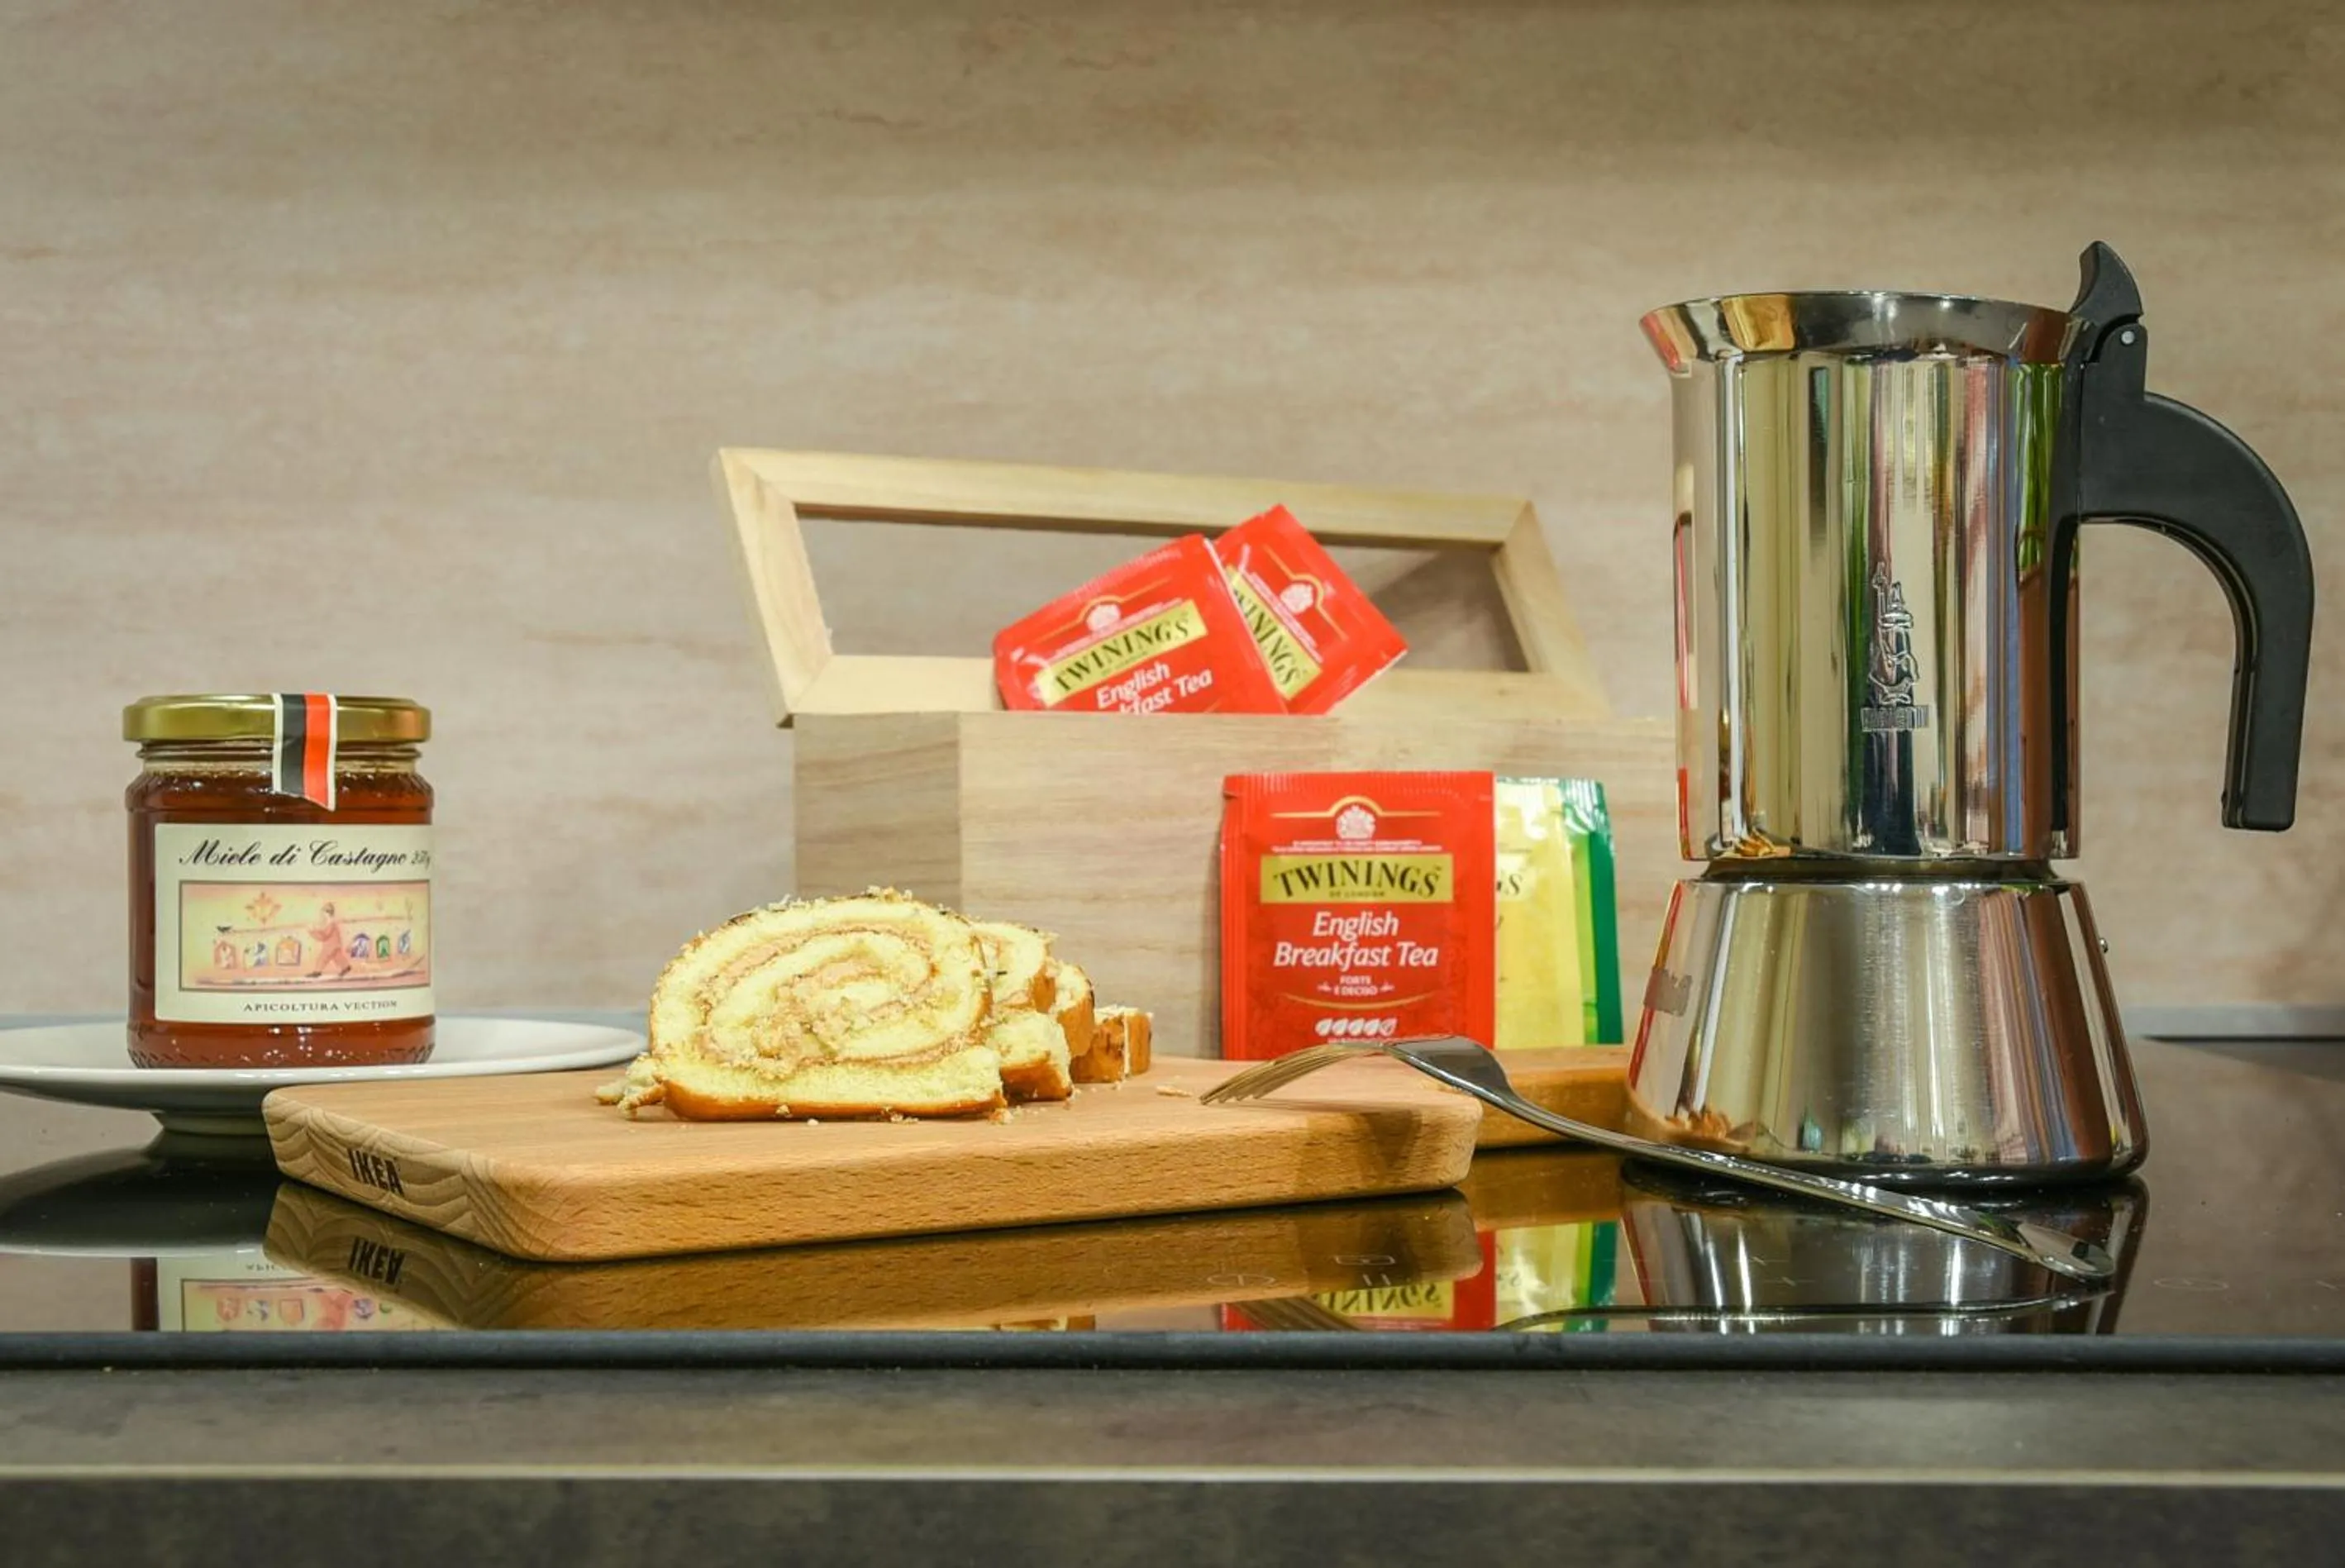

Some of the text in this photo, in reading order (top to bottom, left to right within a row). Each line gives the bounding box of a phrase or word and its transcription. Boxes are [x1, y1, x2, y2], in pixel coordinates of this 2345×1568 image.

[1234, 589, 1302, 684] ININGS
[1054, 618, 1189, 692] TWININGS
[1097, 660, 1170, 709] English
[1173, 668, 1213, 698] Tea
[179, 839, 262, 865] Miele
[269, 843, 302, 865] di
[1273, 860, 1440, 898] TWININGS
[1313, 910, 1399, 942] English
[1273, 940, 1439, 972] Breakfast Tea
[243, 1002, 339, 1013] APICOLTURA
[347, 1147, 405, 1196] IKEA
